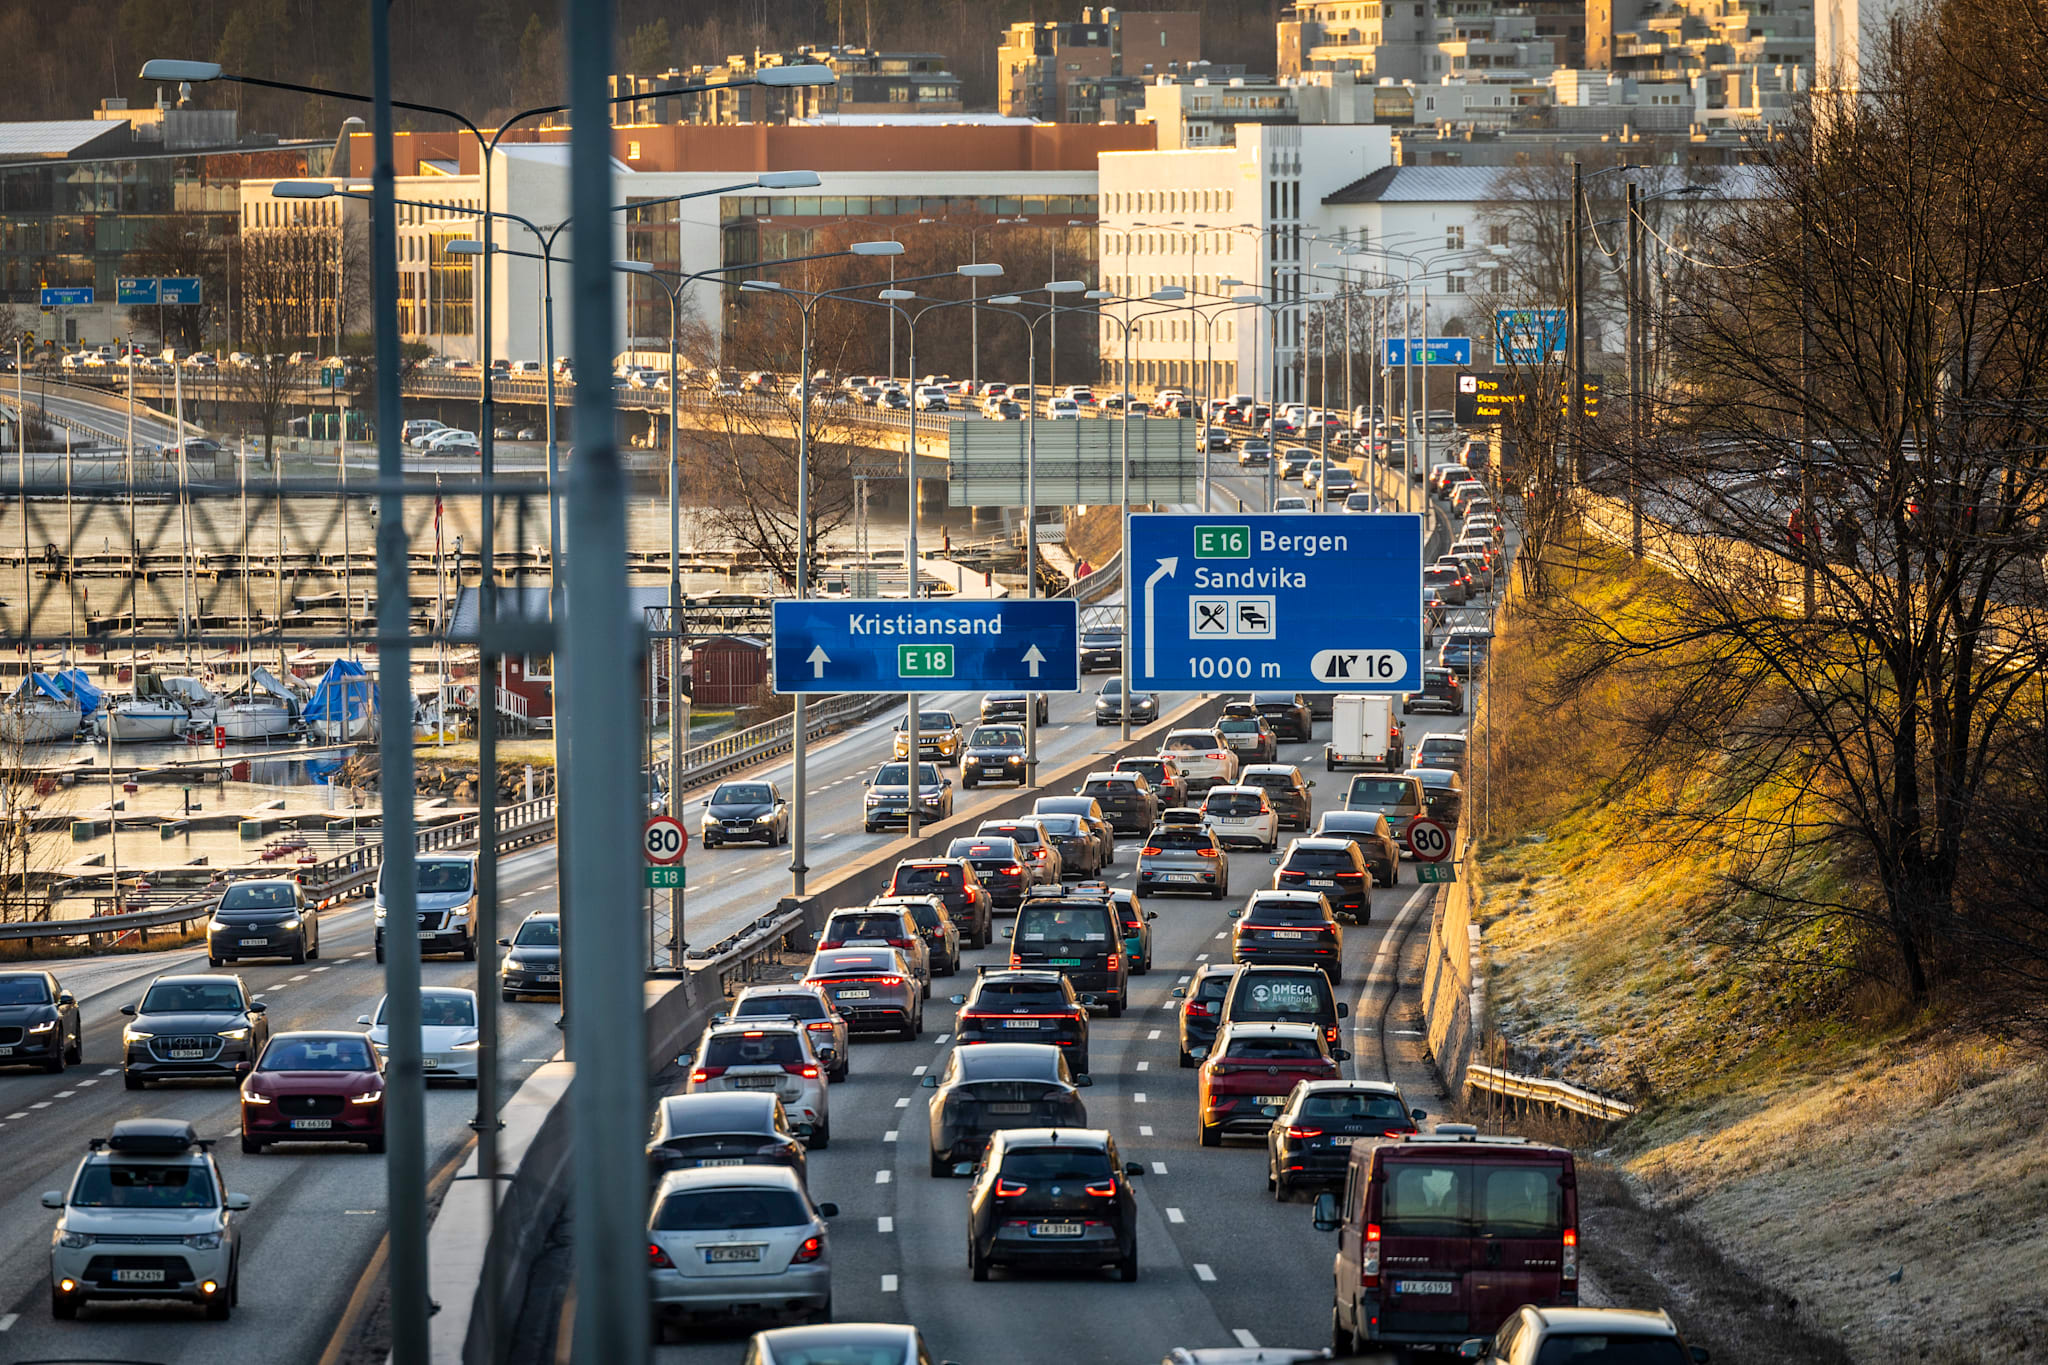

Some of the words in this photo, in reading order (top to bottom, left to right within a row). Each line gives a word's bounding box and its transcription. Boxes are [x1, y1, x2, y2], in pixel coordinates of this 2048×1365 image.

[1202, 533, 1214, 551] E
[1221, 533, 1243, 551] 16
[1260, 530, 1348, 557] Bergen
[1195, 567, 1307, 588] Sandvika
[849, 613, 1002, 635] Kristiansand
[906, 651, 919, 670] E
[925, 651, 946, 670] 18
[1189, 656, 1252, 679] 1000
[1261, 661, 1282, 679] m
[1365, 654, 1394, 678] 16
[648, 828, 680, 852] 80
[1414, 828, 1444, 851] 80
[651, 871, 661, 884] E
[664, 871, 679, 884] 18
[1423, 867, 1433, 880] E
[1434, 866, 1449, 879] 18
[1272, 984, 1313, 996] OMEGA
[1403, 1281, 1417, 1292] UX
[1421, 1281, 1451, 1293] 56195
